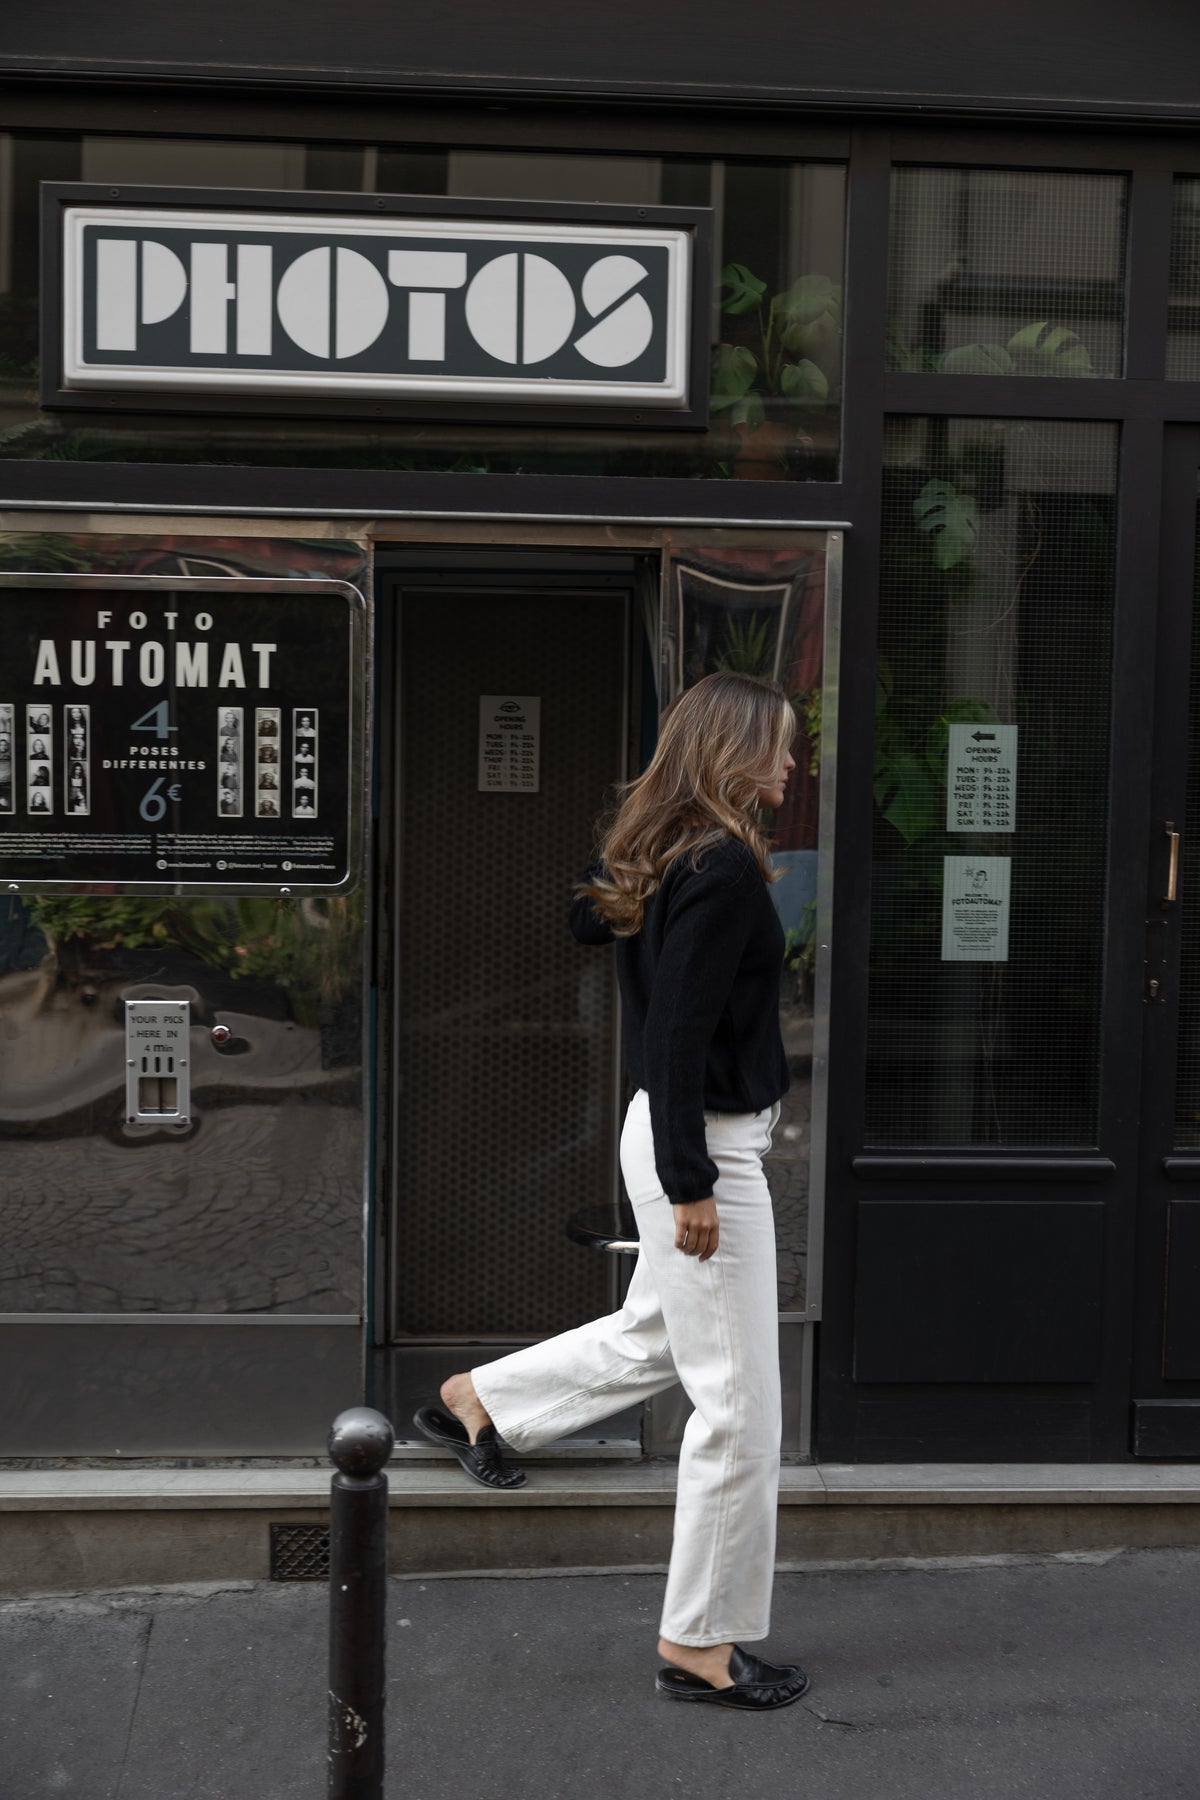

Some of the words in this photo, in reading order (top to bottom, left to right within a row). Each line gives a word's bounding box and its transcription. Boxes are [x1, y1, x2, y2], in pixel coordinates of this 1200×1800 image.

[97, 238, 654, 368] PHOTOS
[97, 611, 214, 631] FOTO
[33, 639, 278, 689] AUTOMAT
[130, 700, 179, 739] 4
[130, 746, 179, 756] POSES
[102, 759, 206, 770] DIFFERENTES
[952, 898, 1003, 906] FOTOAUTOMAT
[130, 1016, 157, 1024] YOUR
[163, 1016, 184, 1024] PICS
[137, 1030, 161, 1038] HERE
[144, 1044, 150, 1052] 4
